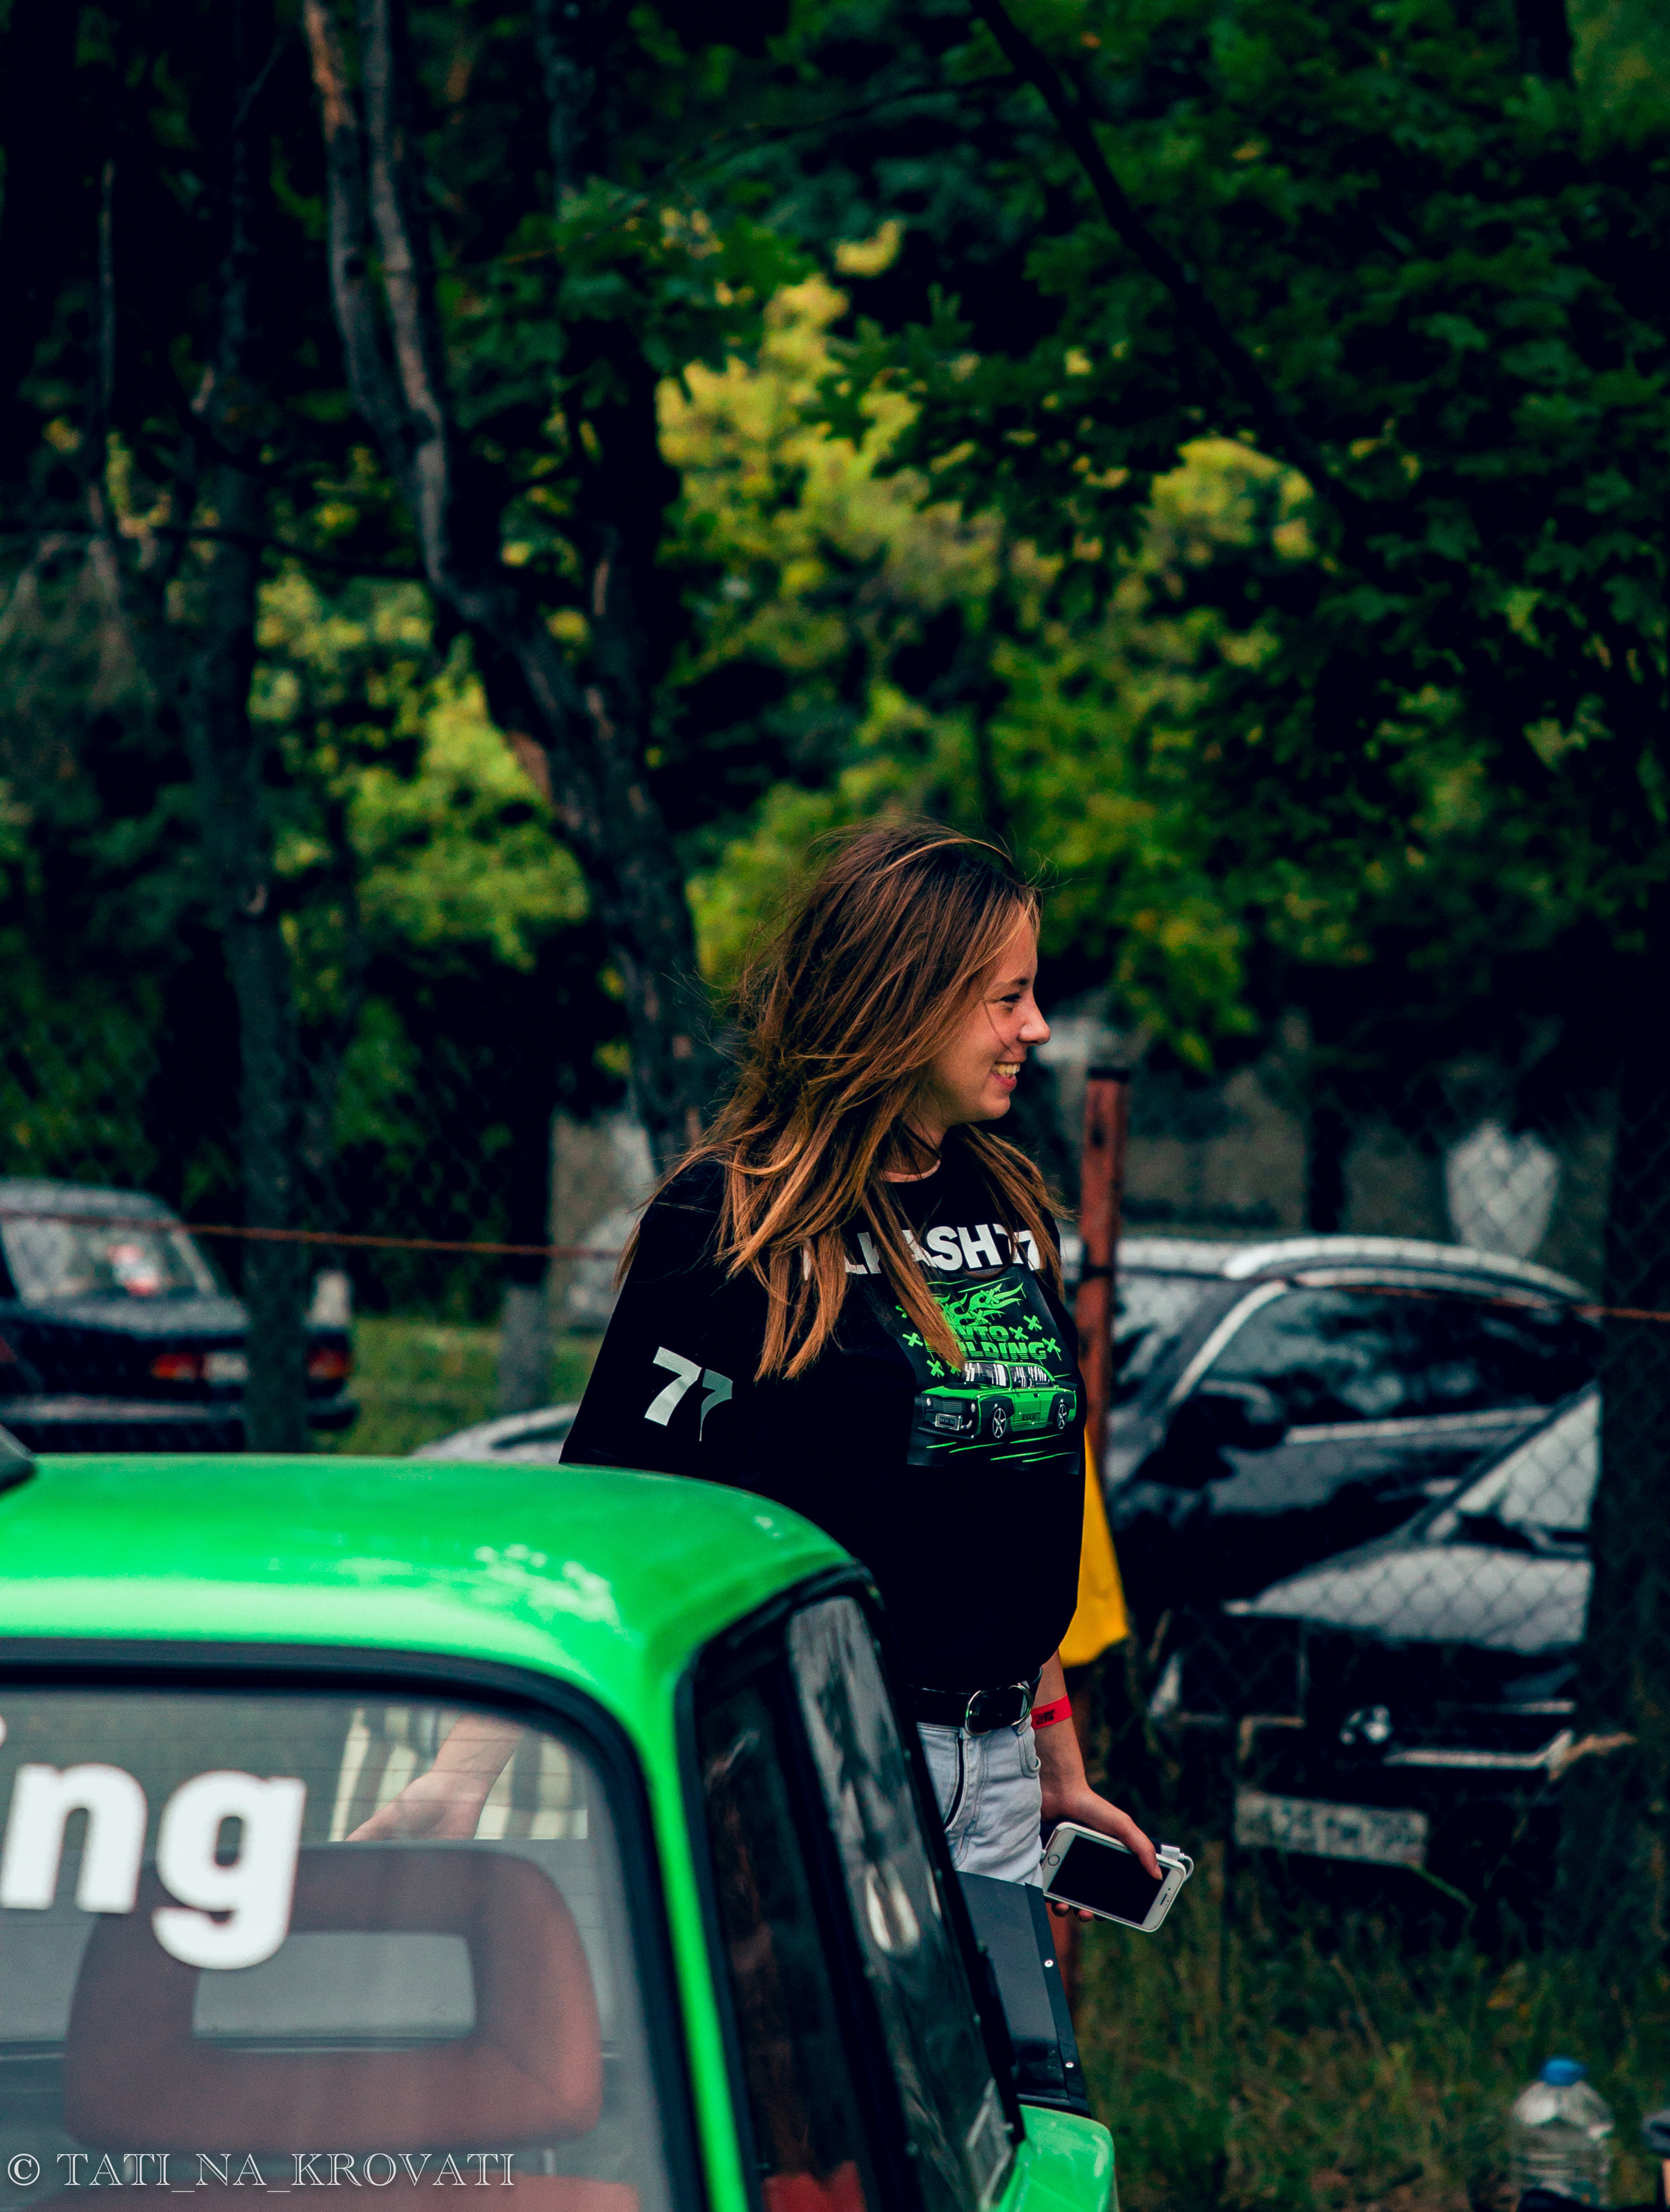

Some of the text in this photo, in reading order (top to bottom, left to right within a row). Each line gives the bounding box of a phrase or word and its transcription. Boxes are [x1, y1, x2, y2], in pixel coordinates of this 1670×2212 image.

[644, 1346, 733, 1442] 77
[924, 1340, 1046, 1359] ILDING
[0, 1716, 307, 1970] ng
